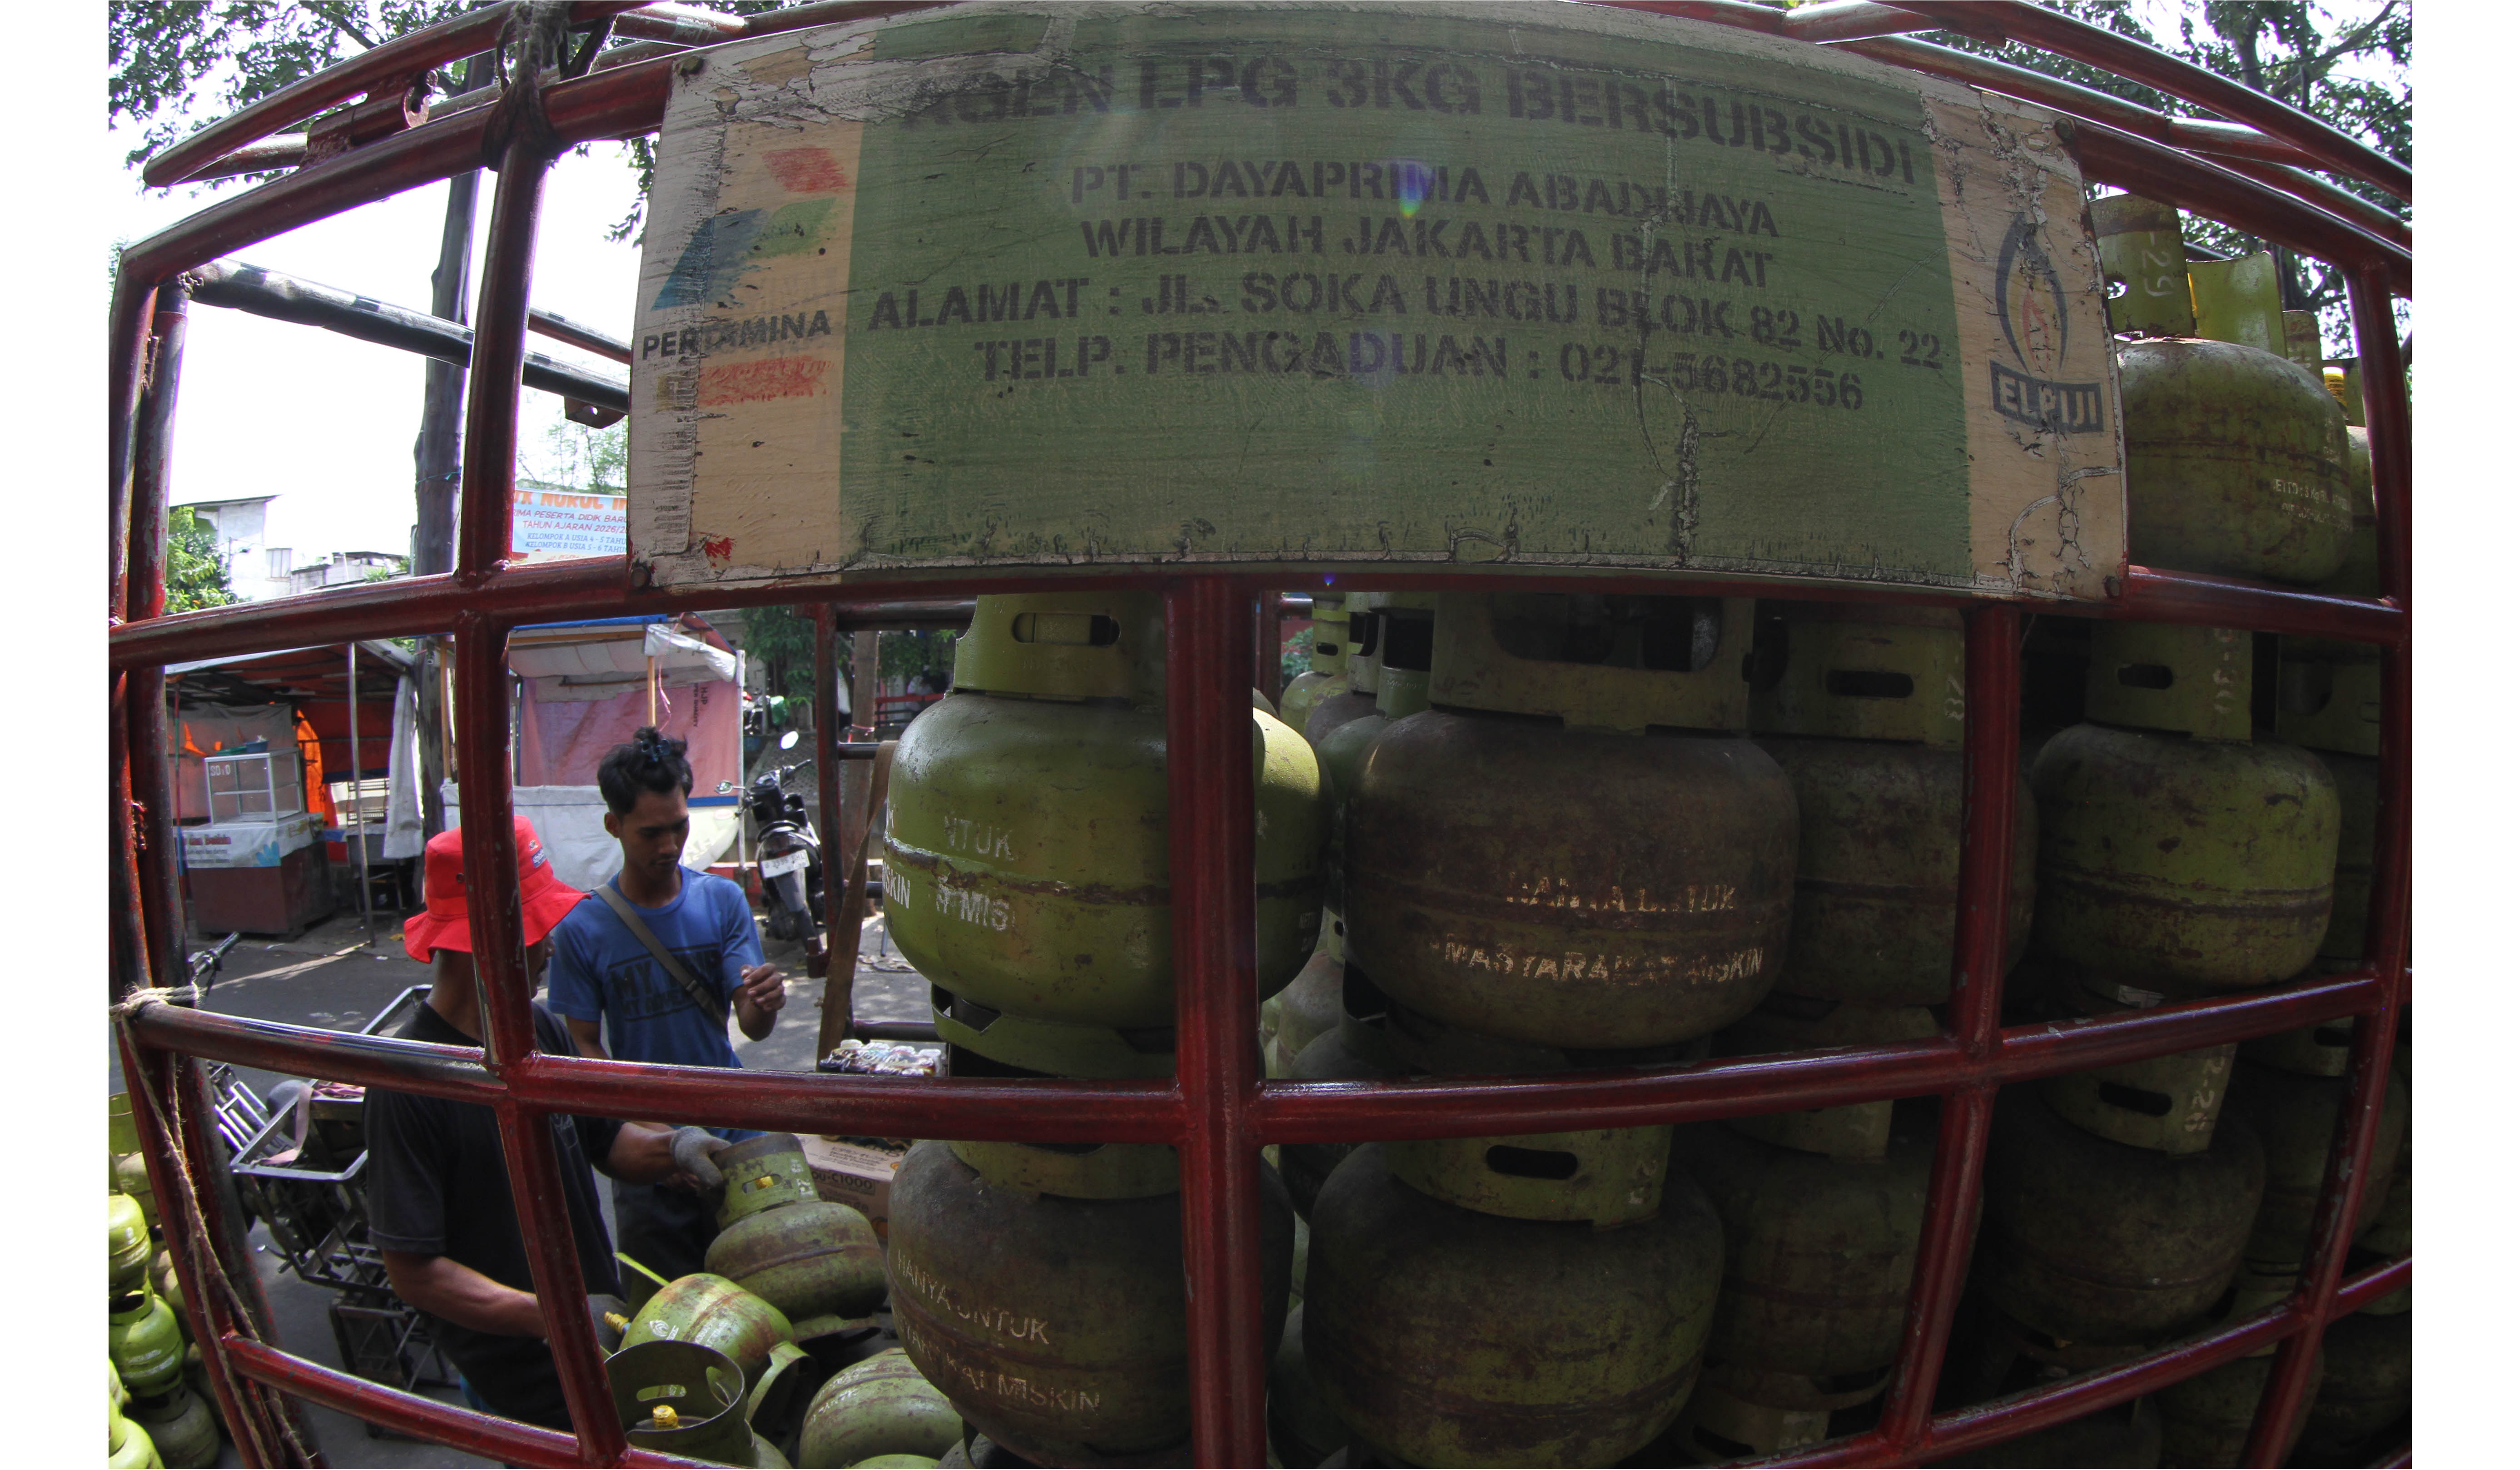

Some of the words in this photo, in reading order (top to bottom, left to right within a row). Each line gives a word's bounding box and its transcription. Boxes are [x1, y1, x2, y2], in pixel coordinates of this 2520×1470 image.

[1140, 51, 1298, 110] LPG
[1327, 59, 1481, 116] 3KG
[1508, 67, 1915, 184] BERSUBSIDI
[1072, 164, 1152, 204] PT.
[1173, 159, 1489, 204] DAYAPRIMA
[1081, 214, 1325, 258] WILAYAH
[1343, 216, 1596, 268] JAKARTA
[1612, 233, 1773, 288] BARAT
[868, 277, 1090, 332] ALAMAT
[1241, 272, 1407, 315] SOKA
[1426, 274, 1579, 325] UNGU
[1596, 285, 1735, 339] BLOK
[1750, 305, 1802, 347] 82
[1818, 313, 1884, 360] No.
[1899, 328, 1943, 370] 22
[975, 334, 1126, 382] TELP.
[1147, 329, 1507, 380] PENGADUAN
[2000, 373, 2098, 427] ELPIJI
[523, 520, 552, 529] TAHUN
[554, 522, 593, 531] AJARAN
[534, 510, 575, 519] PESERTA
[578, 513, 601, 522] DIDIK
[540, 493, 604, 509] NURUL
[898, 1249, 951, 1311] HANYA
